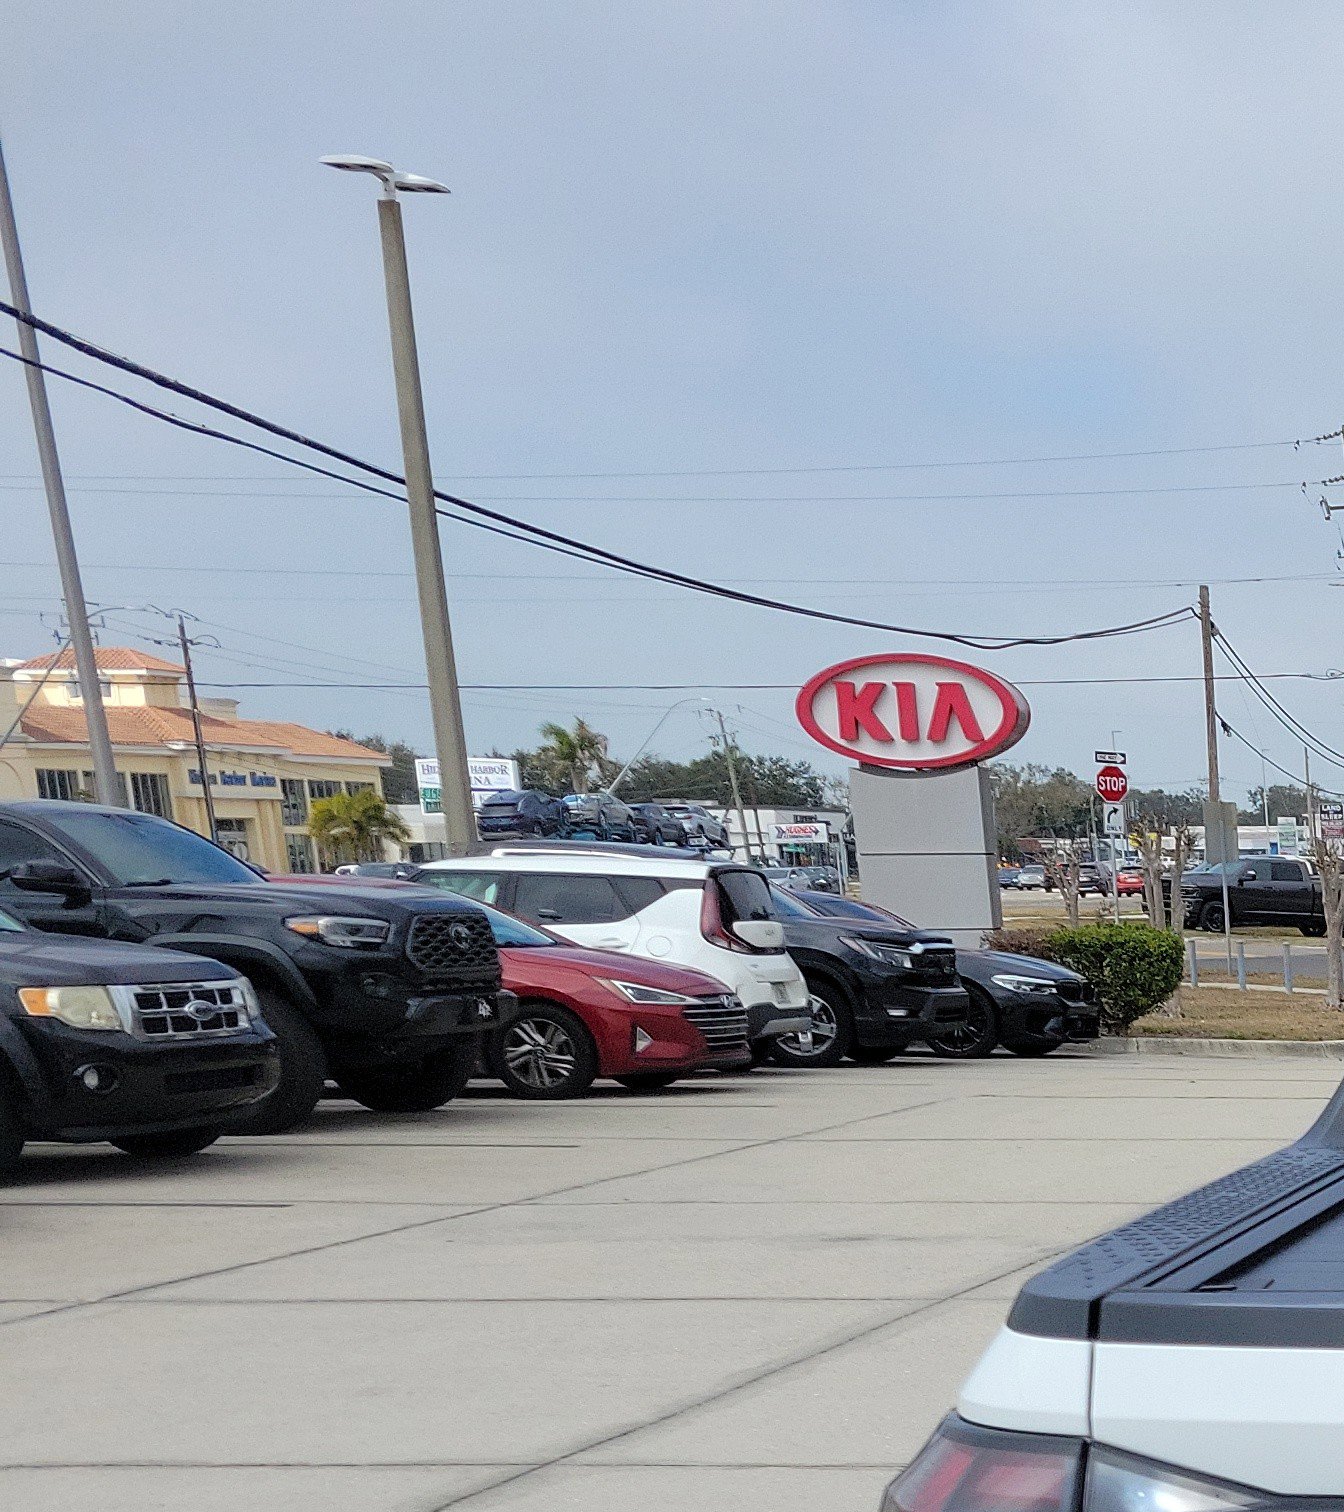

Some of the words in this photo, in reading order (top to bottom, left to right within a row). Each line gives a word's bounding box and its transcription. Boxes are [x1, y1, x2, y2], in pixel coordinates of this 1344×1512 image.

[833, 681, 985, 742] KIA
[471, 764, 508, 775] HARBOR
[1099, 776, 1126, 791] STOP
